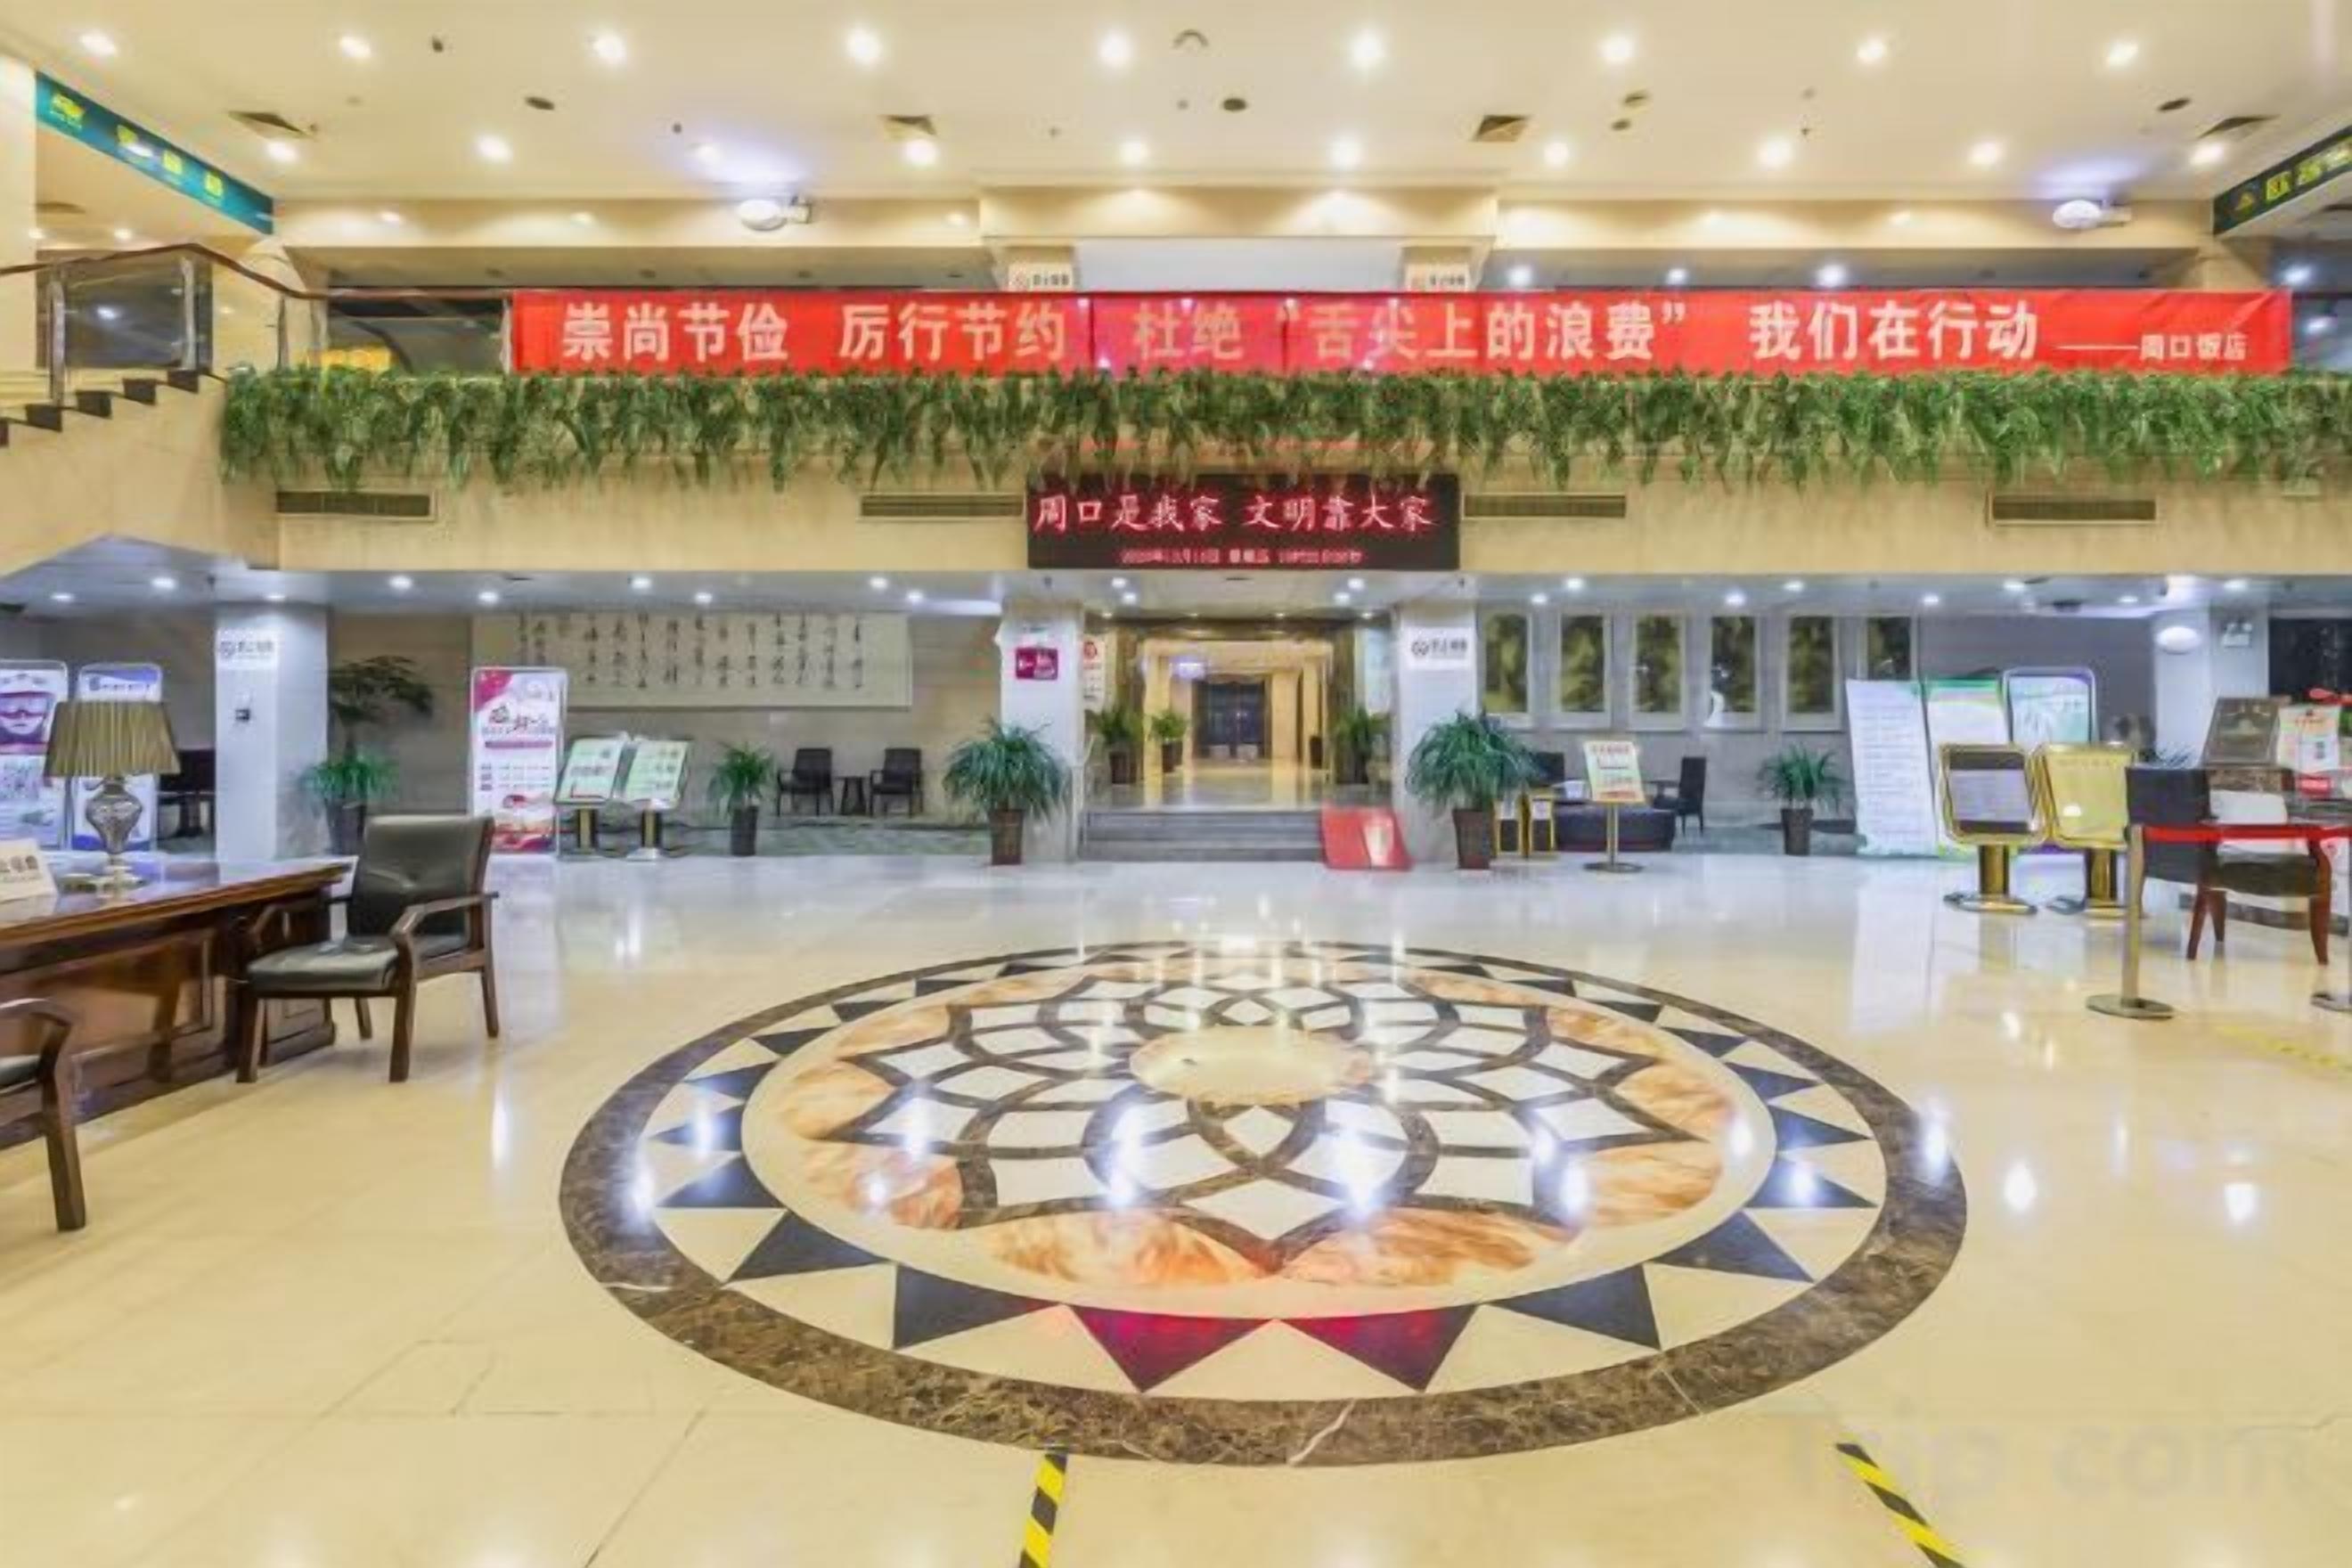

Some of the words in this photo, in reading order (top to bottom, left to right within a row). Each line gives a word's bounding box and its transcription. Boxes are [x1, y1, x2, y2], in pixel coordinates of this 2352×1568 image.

[561, 301, 788, 361] 崇尚节俭
[838, 302, 1067, 361] 厉行节约
[1133, 301, 1245, 361] 杜绝
[1748, 298, 2039, 362] 我们在行动
[1242, 494, 1440, 533] 文明靠大家
